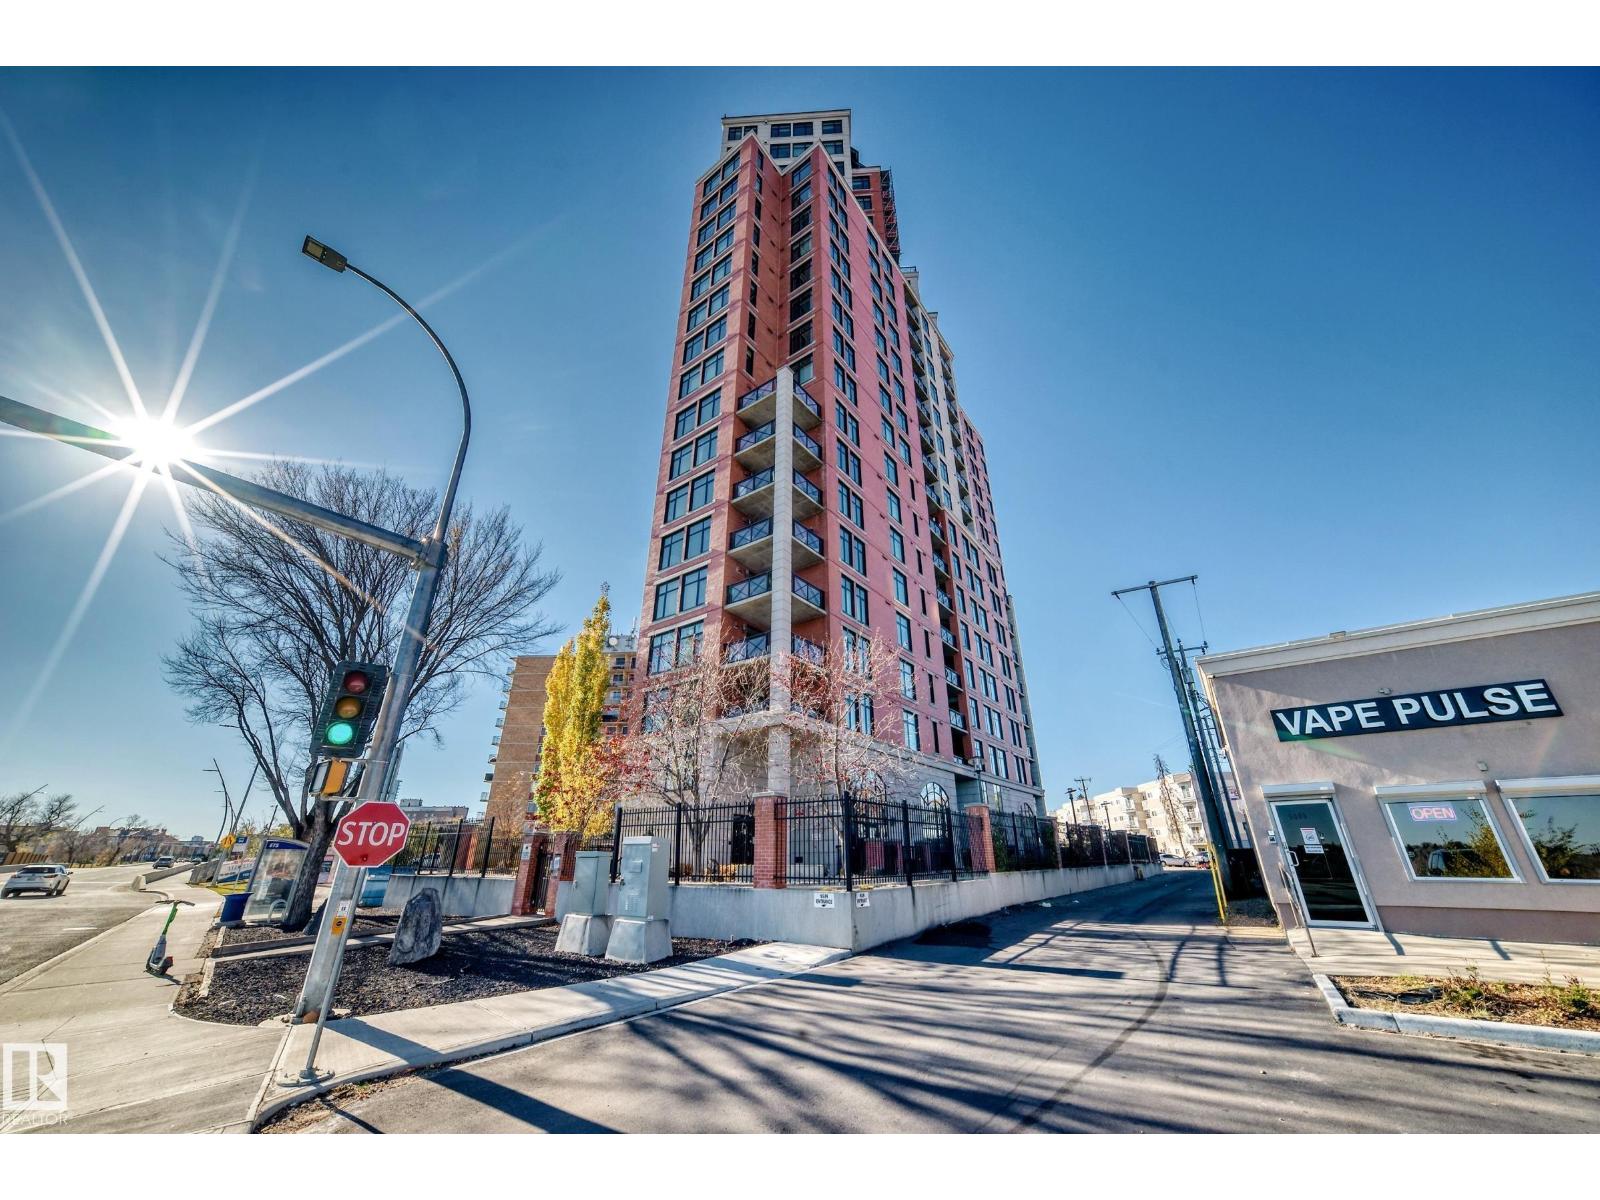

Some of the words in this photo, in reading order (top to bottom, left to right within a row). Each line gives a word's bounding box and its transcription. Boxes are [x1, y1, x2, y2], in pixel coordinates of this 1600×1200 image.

[1276, 702, 1385, 736] VAPE
[1393, 682, 1557, 725] PULSE
[1412, 807, 1454, 820] OPEN
[337, 822, 406, 847] STOP
